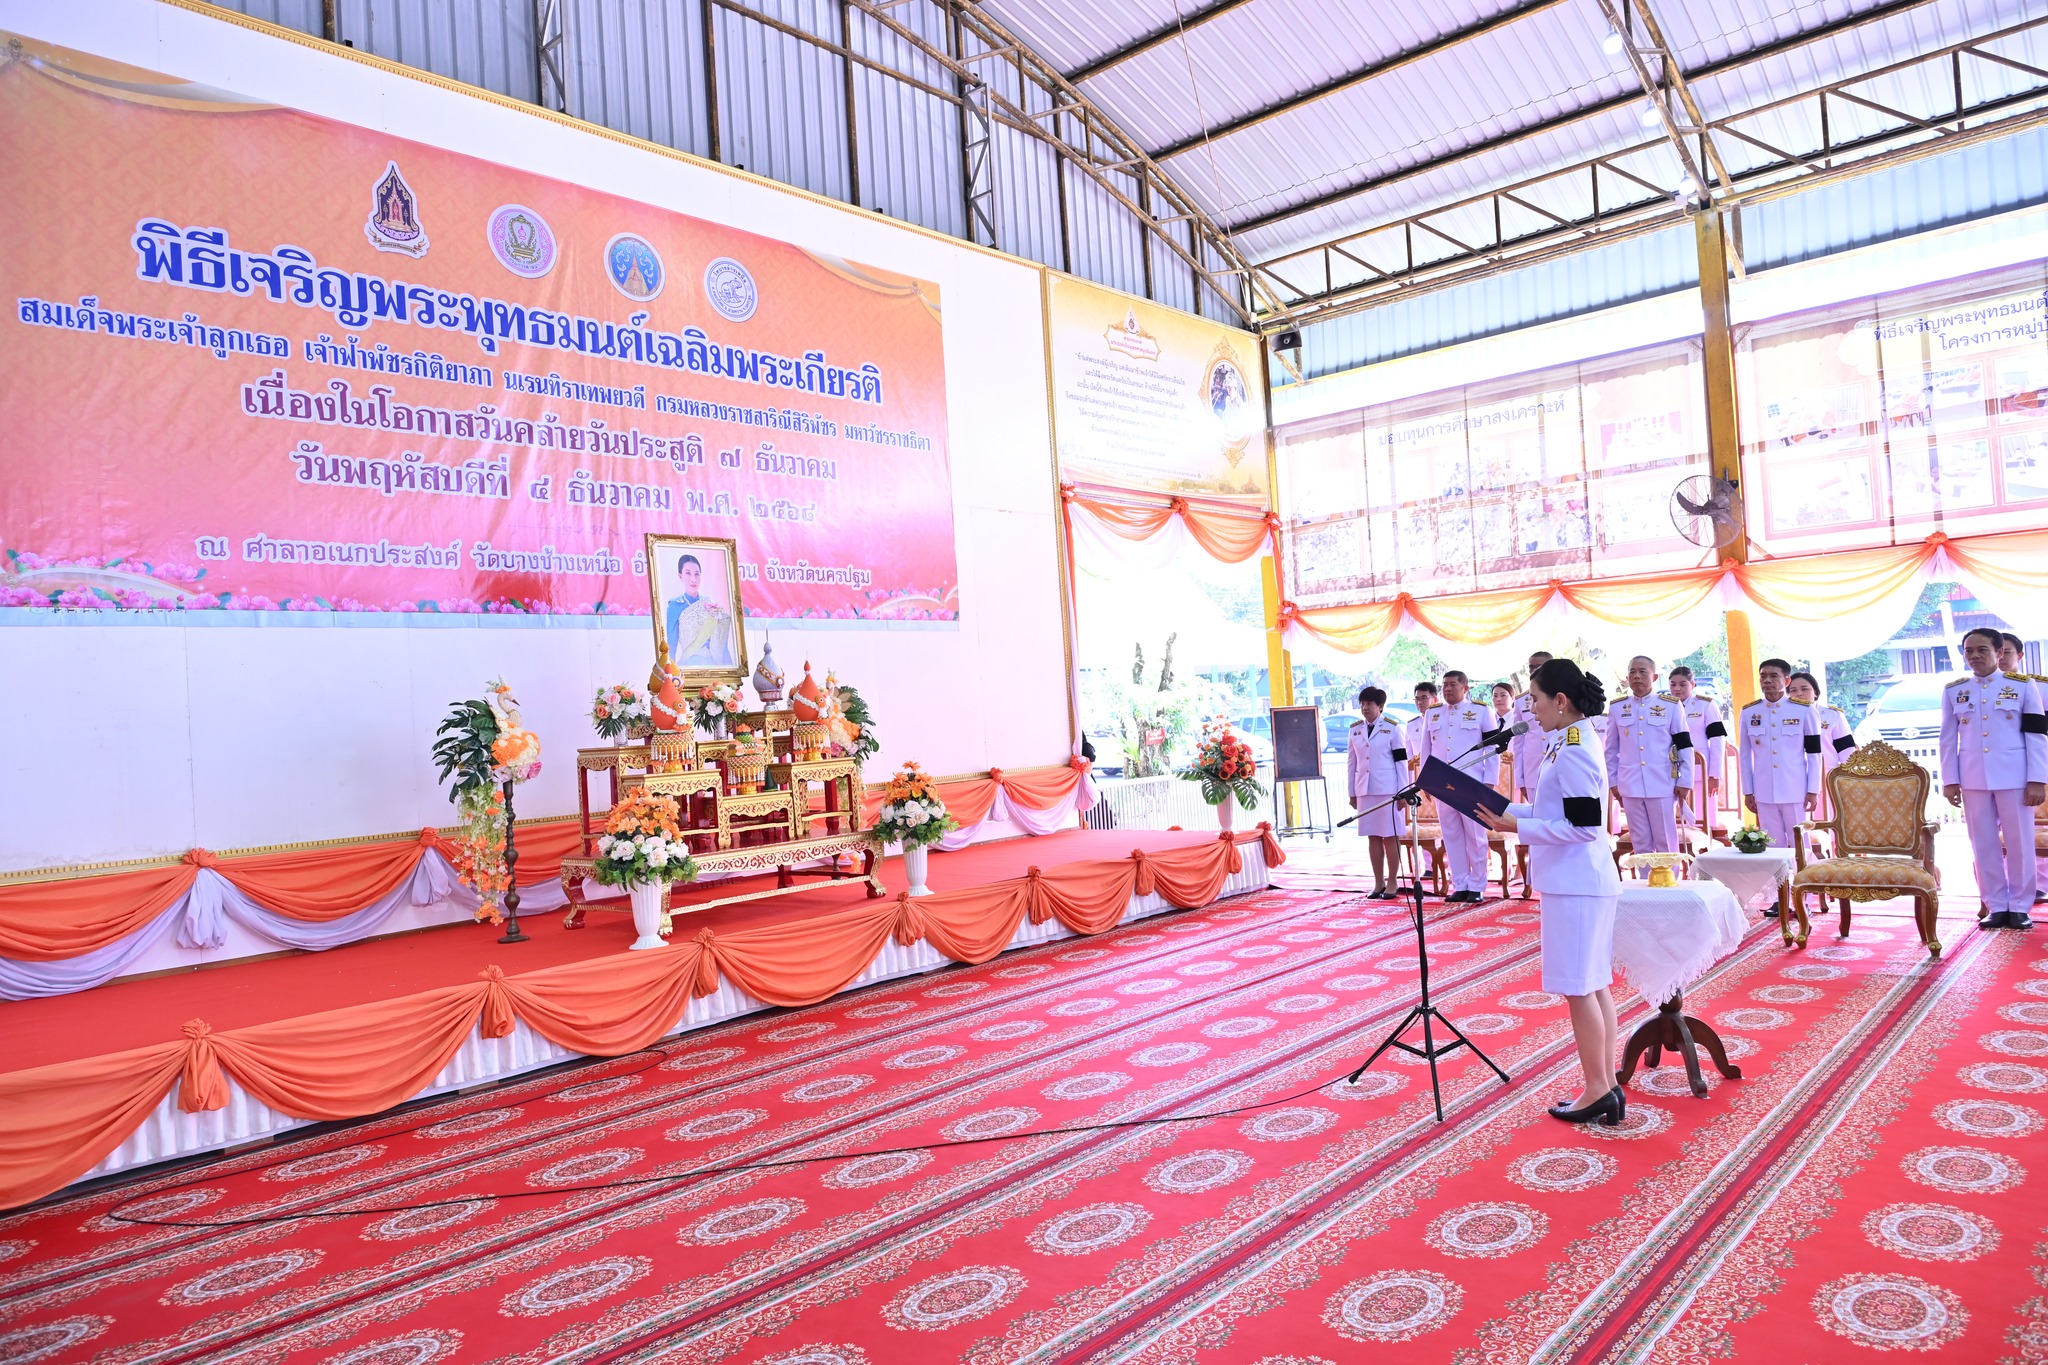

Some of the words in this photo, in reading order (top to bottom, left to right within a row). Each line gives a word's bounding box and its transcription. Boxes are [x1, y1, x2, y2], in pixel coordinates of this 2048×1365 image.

[137, 222, 882, 404] พิธีเจริญพระพุทธมนต์เฉลิมพระเกียรติ
[19, 298, 290, 358] สมเด็จพระเจ้าลูกเธอ
[305, 336, 493, 387] เจ้าฟ้าพัชรกิติยาภา
[504, 368, 646, 410] นเรนทิราเทพยวดี
[656, 394, 837, 437] กรมหลวงราชสาริณีสิริพัชร
[844, 423, 931, 451] มหาวัชรราชธิดา
[244, 372, 702, 471] เนื่องในโอกาสวันคล้ายวันประสูติ
[720, 449, 742, 468] ๗
[755, 443, 836, 480] ธันวาคม
[1378, 393, 1565, 447] มอบทุนการศึกษาสงเคราะห์
[295, 443, 508, 497] วันพฤหัสบดีที่
[568, 471, 671, 509] ธันวาคม
[687, 489, 739, 516] พ.ศ.
[198, 538, 228, 558] ณ
[246, 534, 459, 569] ศาลาอเนกประสงค์
[473, 545, 621, 573] วัดบางช้างเหนือ
[766, 560, 871, 590] จังหวัดนครปฐม
